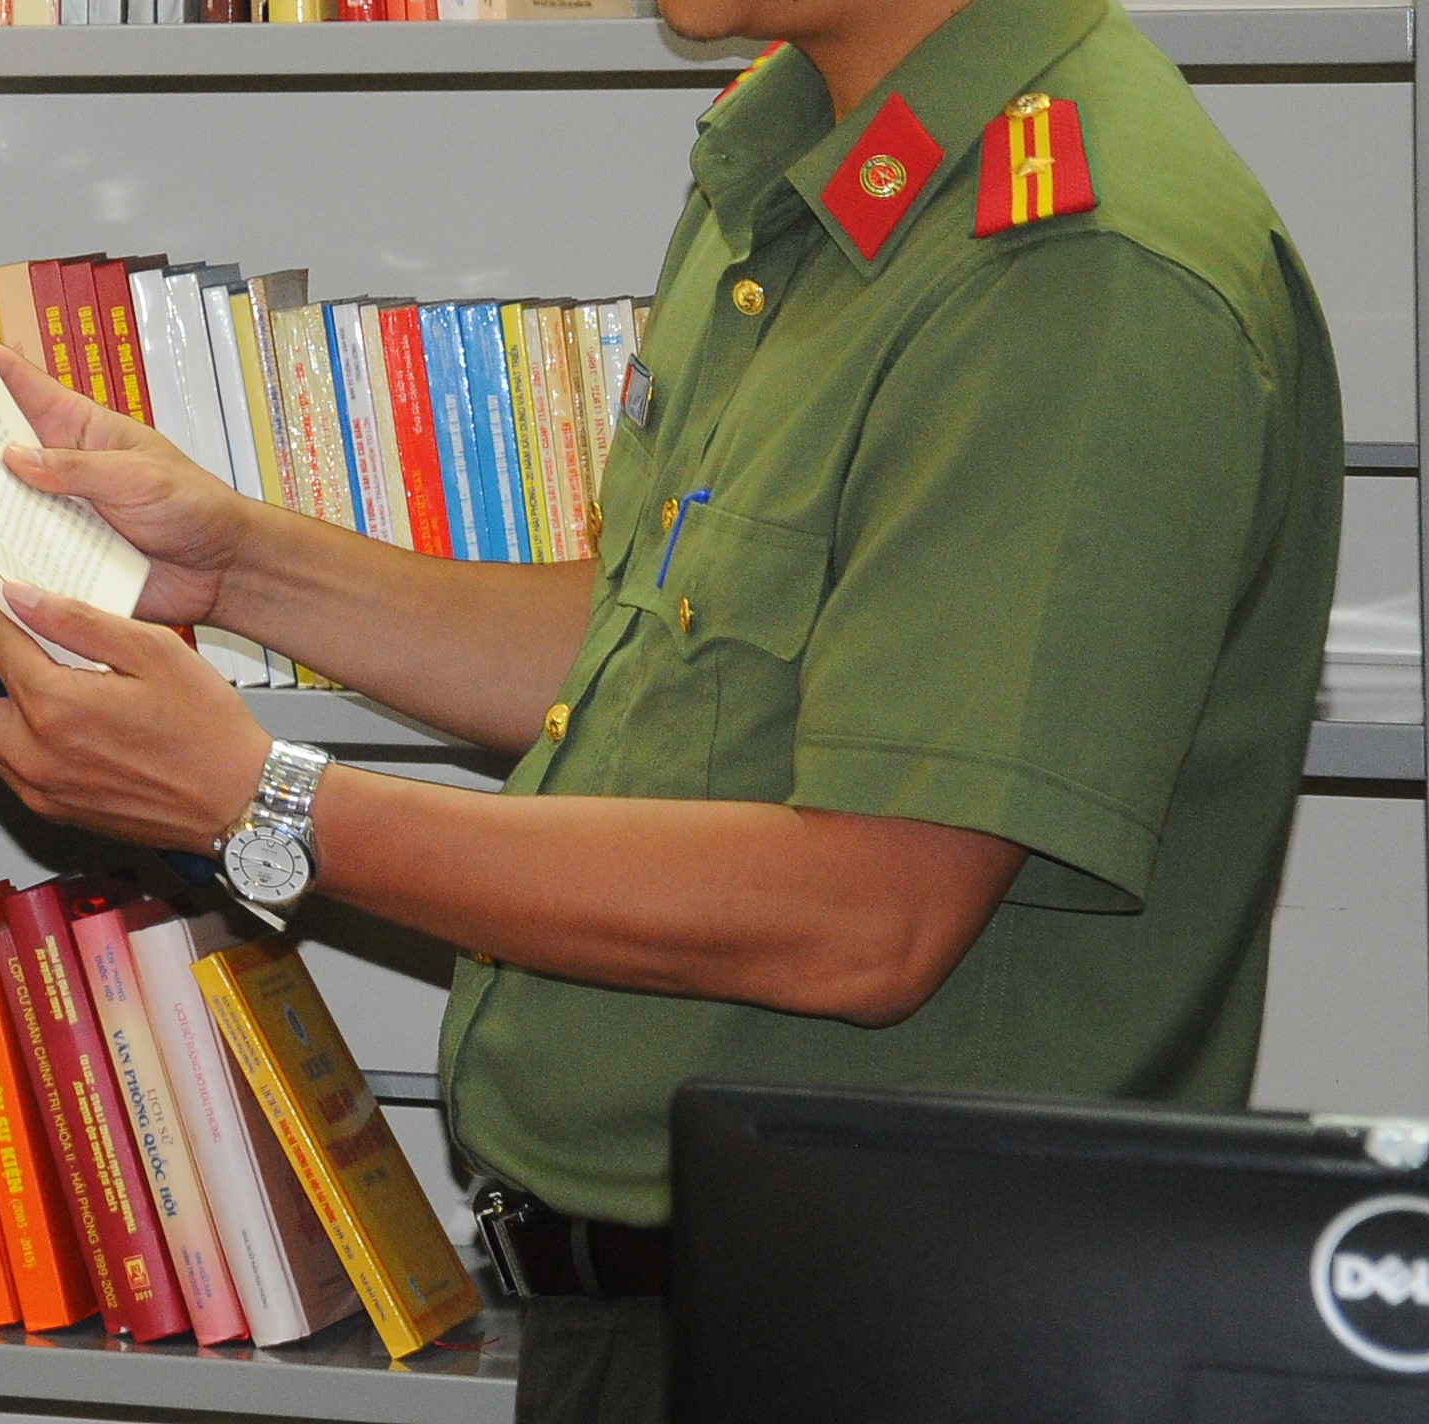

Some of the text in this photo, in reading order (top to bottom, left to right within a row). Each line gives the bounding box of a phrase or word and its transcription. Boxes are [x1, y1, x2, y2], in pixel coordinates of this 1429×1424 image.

[111, 1028, 178, 1220] VĂN PHÒNG QUỐC HỘI
[144, 1087, 175, 1148] LỊCH SỬ
